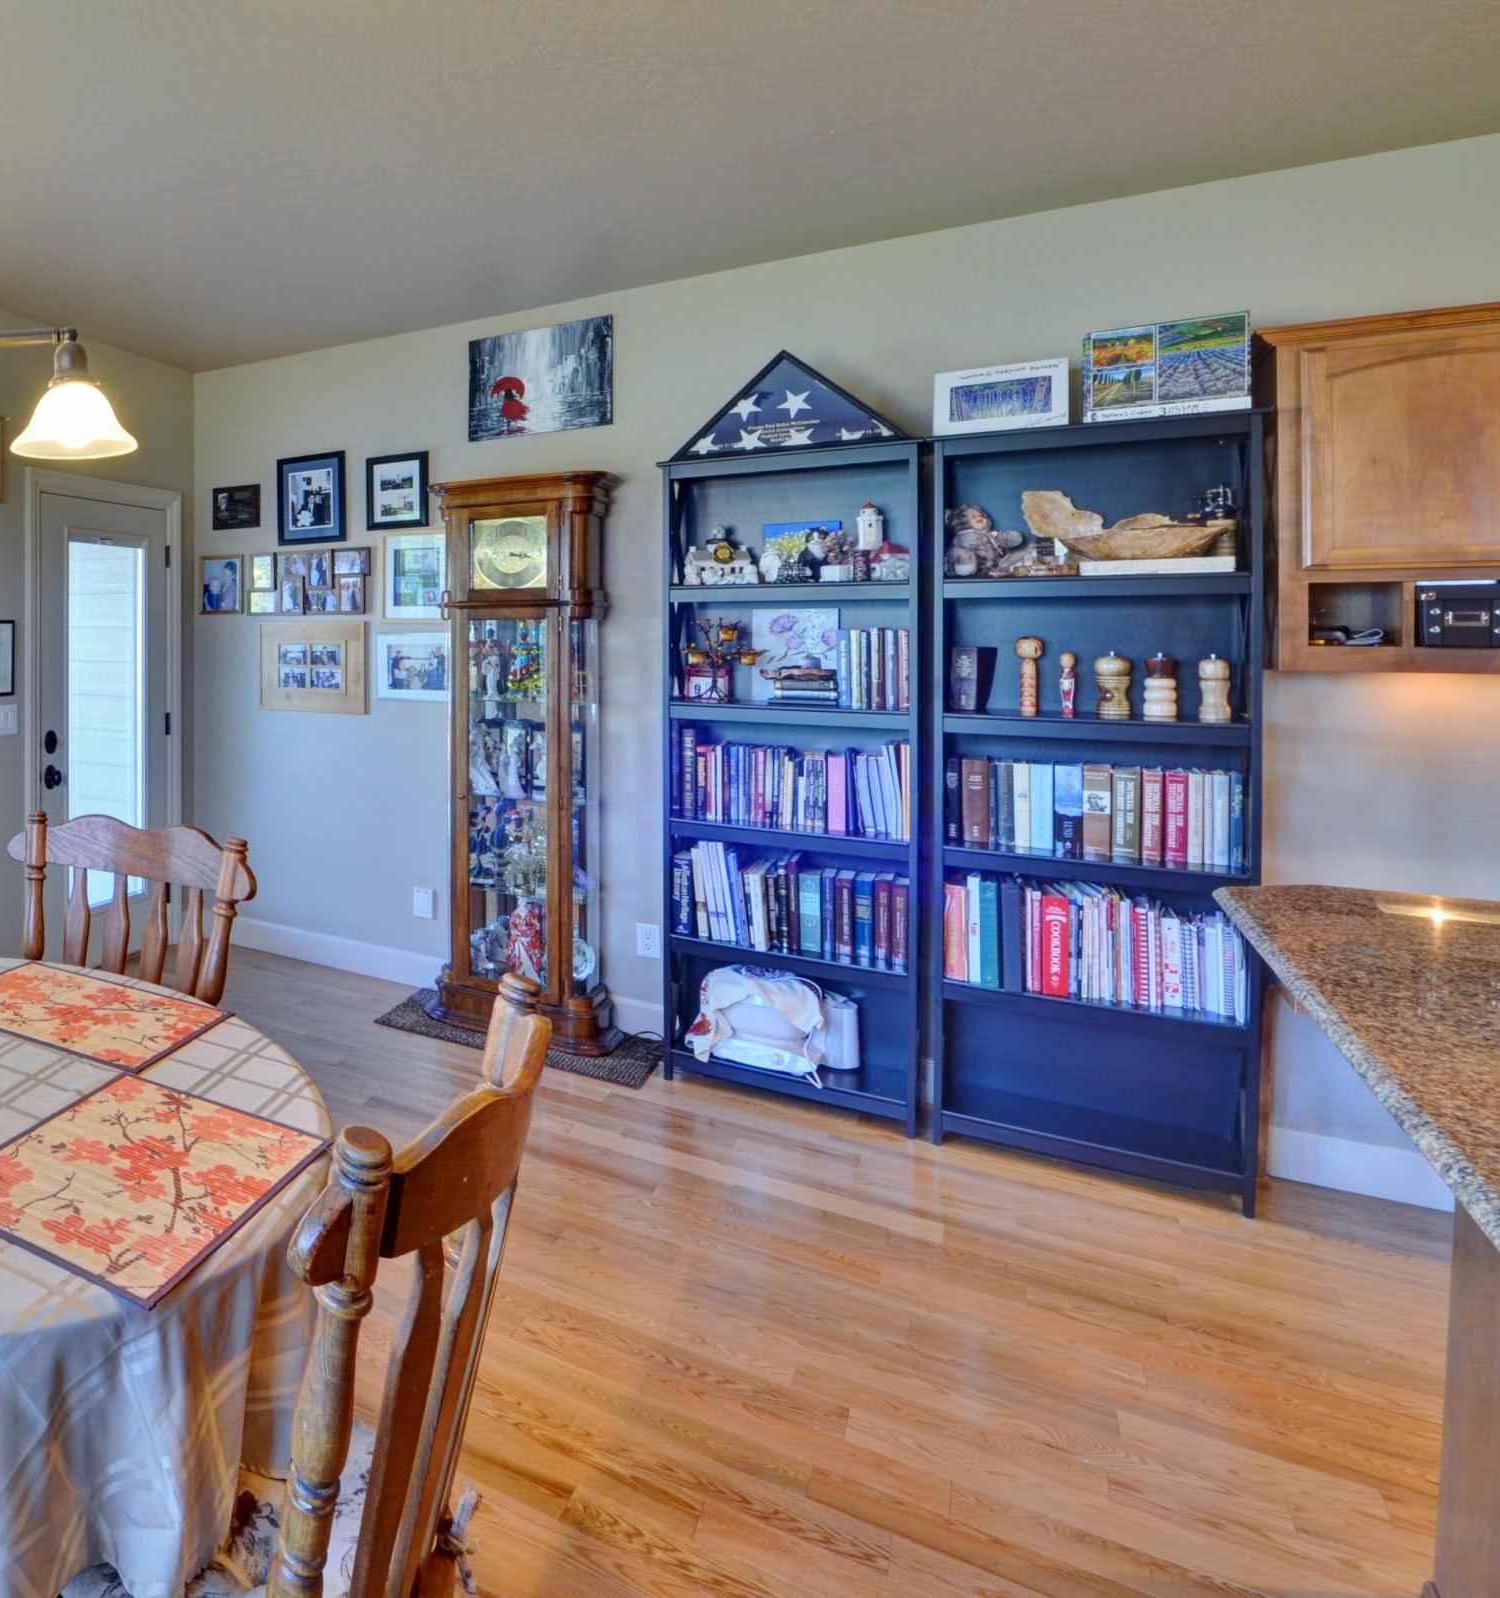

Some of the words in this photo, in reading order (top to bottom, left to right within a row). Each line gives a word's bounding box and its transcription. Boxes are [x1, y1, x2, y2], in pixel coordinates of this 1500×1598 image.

[694, 684, 701, 694] 9
[681, 865, 691, 896] American
[1050, 921, 1061, 974] COOKBOOK
